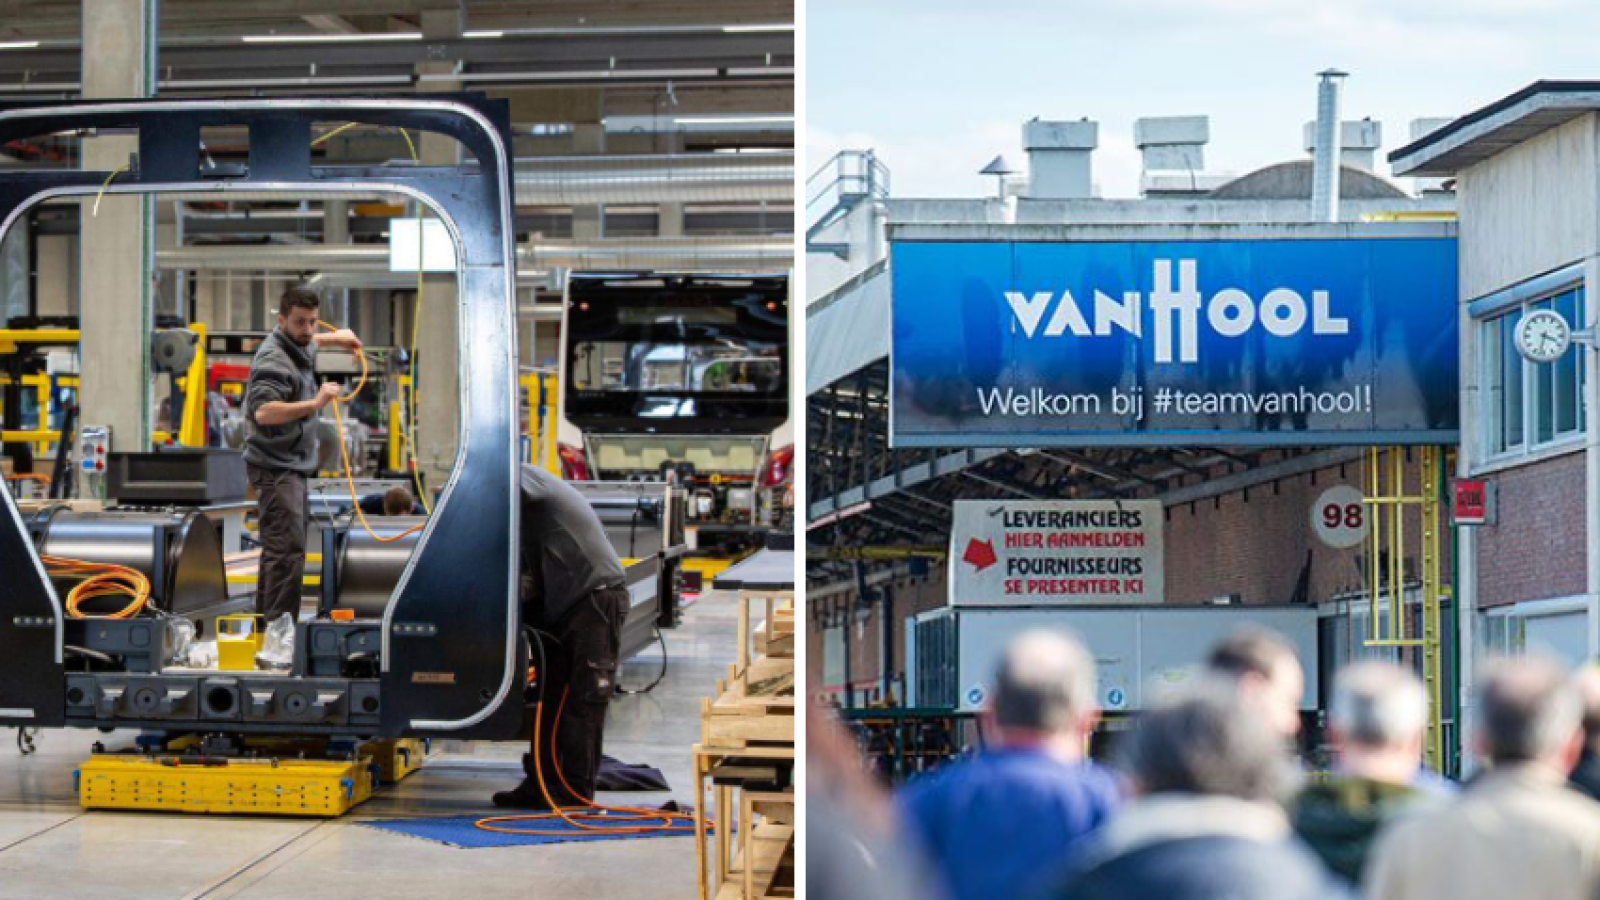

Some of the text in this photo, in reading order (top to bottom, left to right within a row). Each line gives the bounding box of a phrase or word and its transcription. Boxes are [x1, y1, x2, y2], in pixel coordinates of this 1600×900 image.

[977, 385, 1372, 420] Welkom bij #teamvanhool!
[1003, 510, 1142, 528] LEVERANCIERS
[1323, 503, 1362, 528] 98
[1004, 532, 1144, 548] HIER AANMELDEN
[1007, 557, 1143, 575] FOURNISSEURS
[1004, 579, 1143, 595] SE PRESENTER ICI
